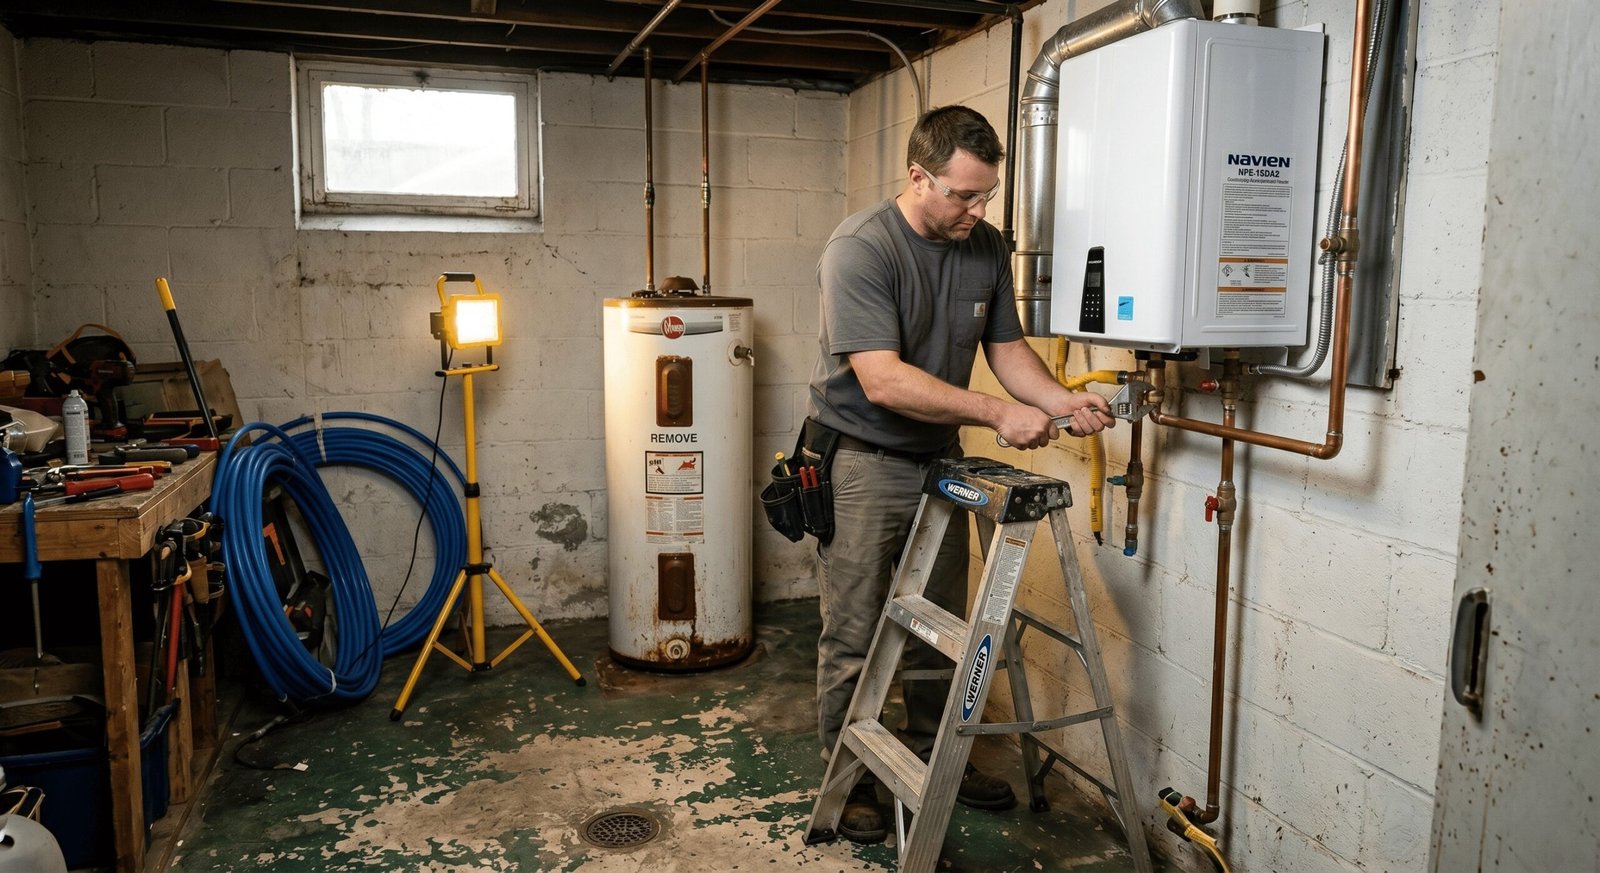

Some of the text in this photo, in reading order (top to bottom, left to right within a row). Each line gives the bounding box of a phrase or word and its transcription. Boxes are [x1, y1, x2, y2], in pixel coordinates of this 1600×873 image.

[650, 433, 698, 443] REMOVE
[947, 483, 980, 501] WERNER
[966, 651, 987, 704] WERNER
